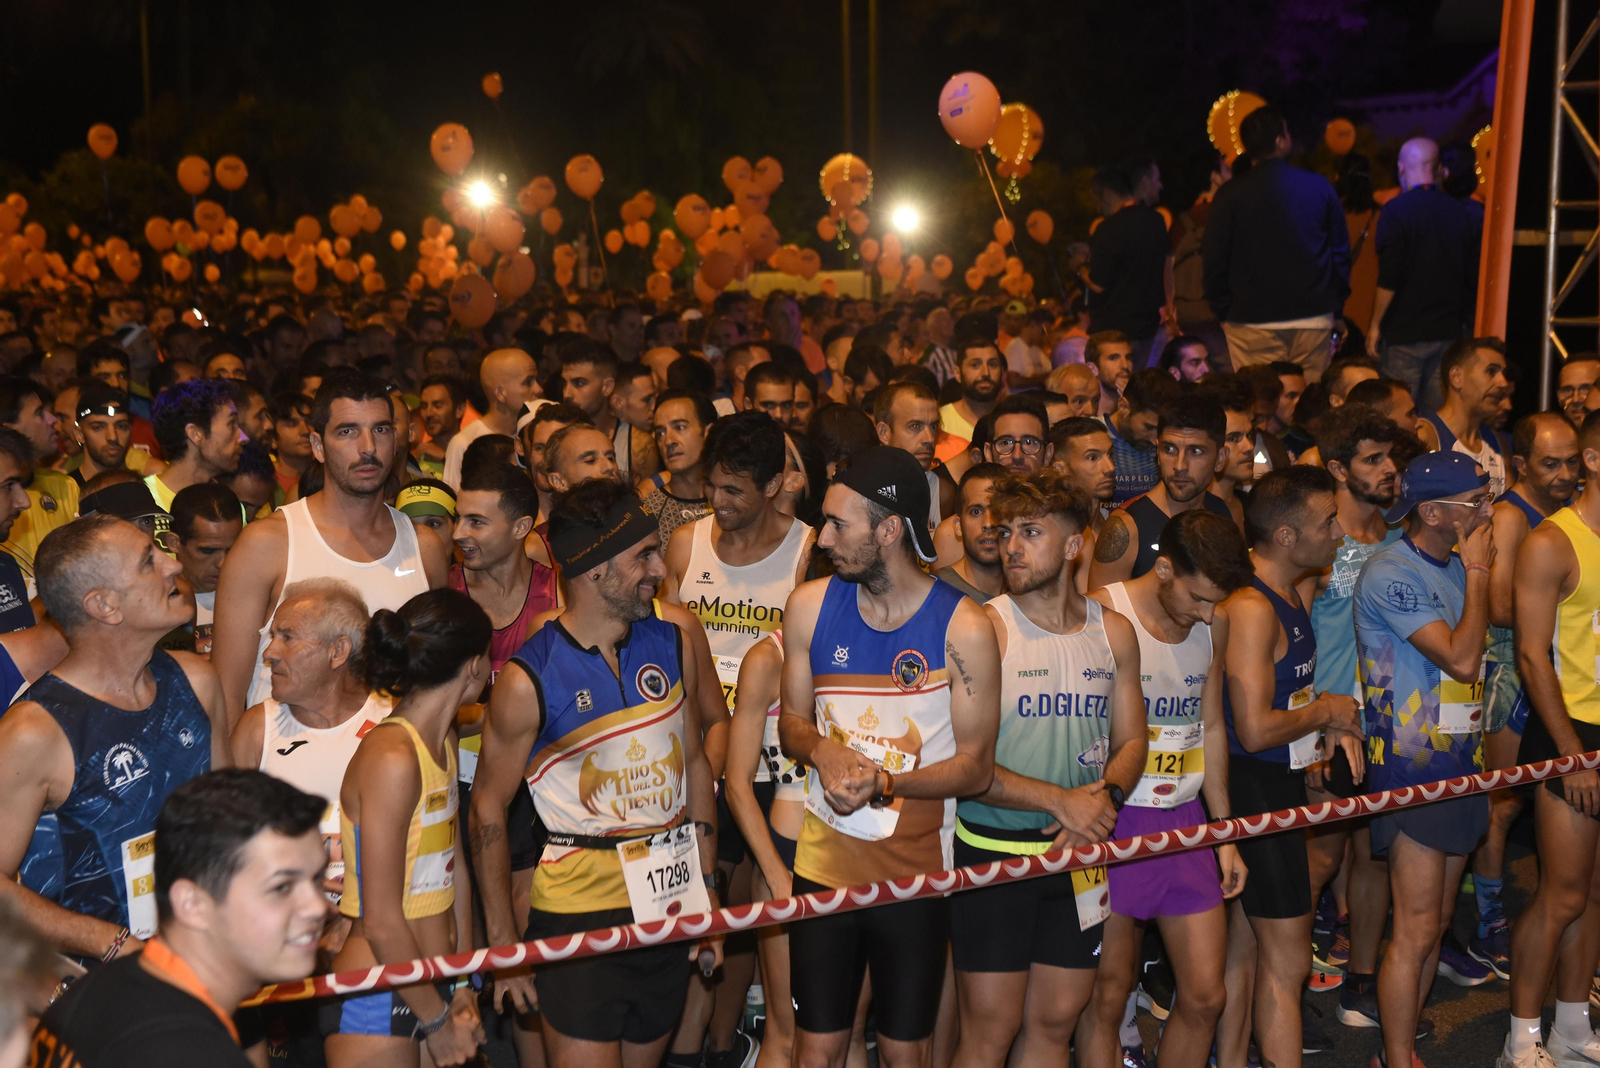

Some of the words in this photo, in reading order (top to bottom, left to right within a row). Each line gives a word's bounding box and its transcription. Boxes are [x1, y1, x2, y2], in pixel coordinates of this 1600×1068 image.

[687, 595, 784, 623] eMotion
[705, 621, 760, 639] running
[1017, 669, 1049, 678] FASTER
[1154, 753, 1185, 774] 121
[614, 760, 666, 797] HIJOS
[633, 781, 651, 793] DEL
[610, 787, 673, 822] VIENTO
[646, 860, 690, 894] 17298
